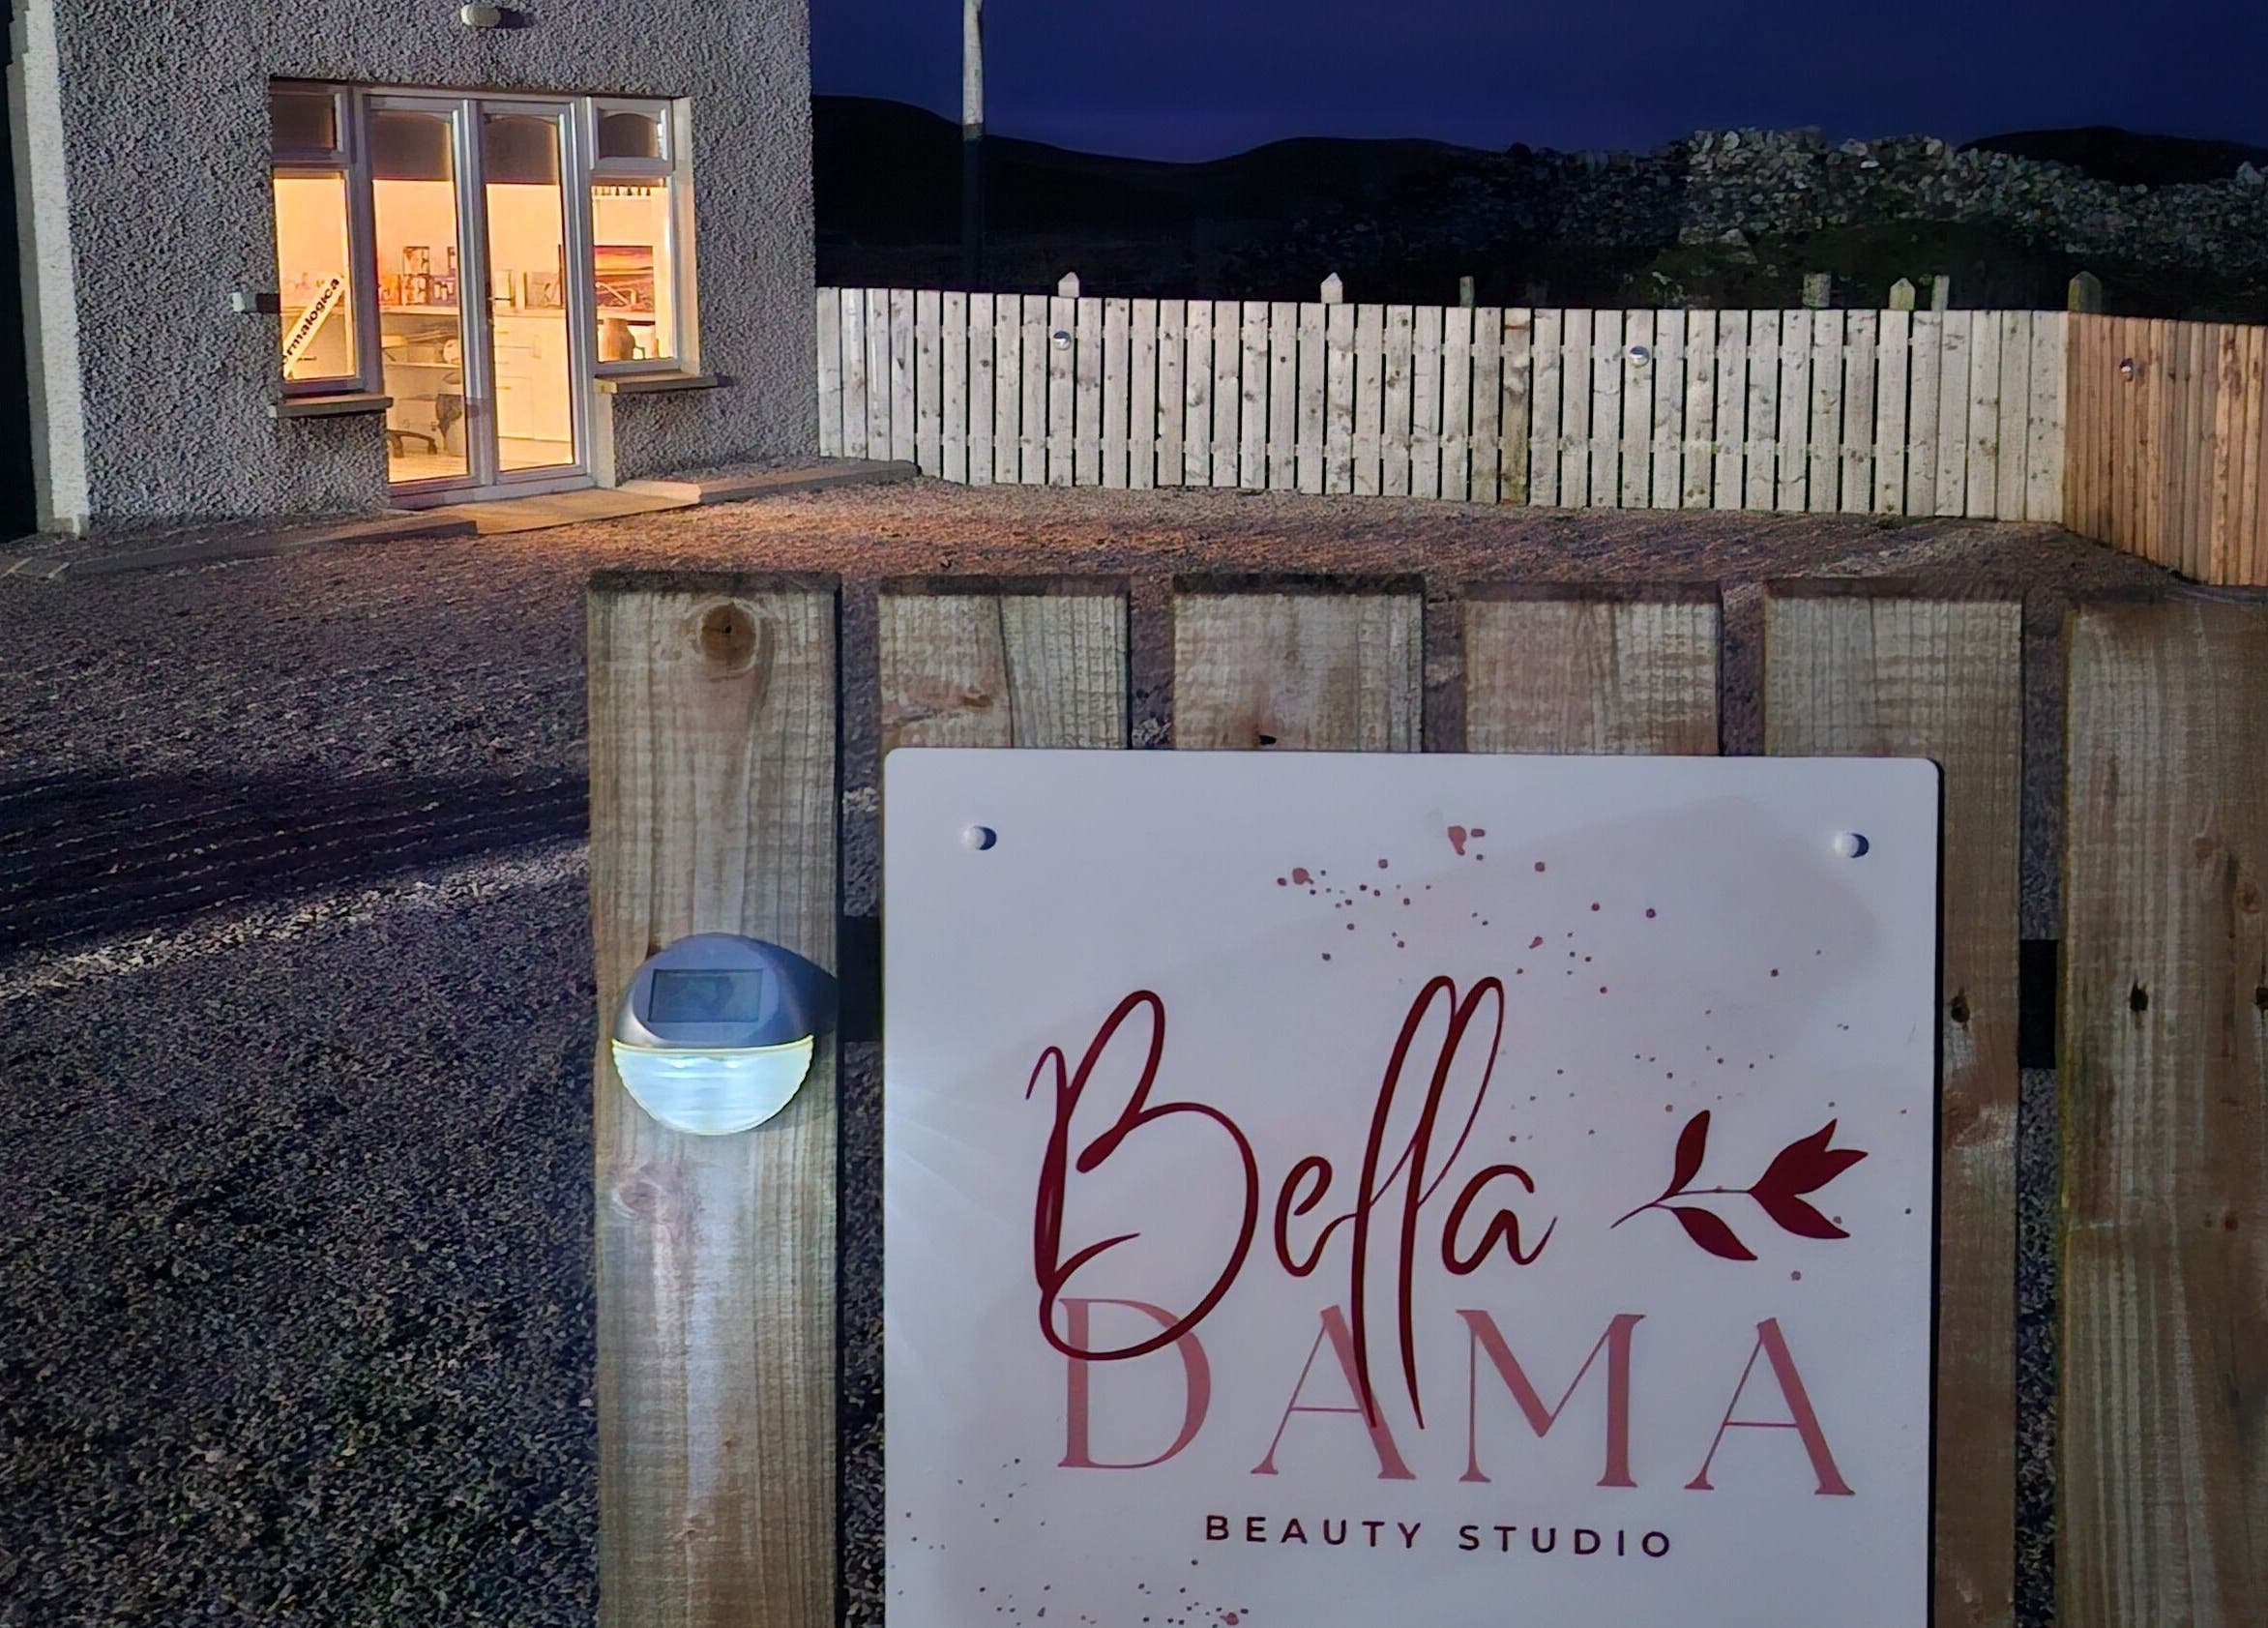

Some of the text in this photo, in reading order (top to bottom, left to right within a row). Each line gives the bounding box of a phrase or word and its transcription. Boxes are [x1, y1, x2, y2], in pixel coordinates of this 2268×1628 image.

[1026, 976, 1558, 1430] Bella
[1059, 1297, 1855, 1495] DAMA
[1206, 1514, 1670, 1558] BEAUTY STUDIO
